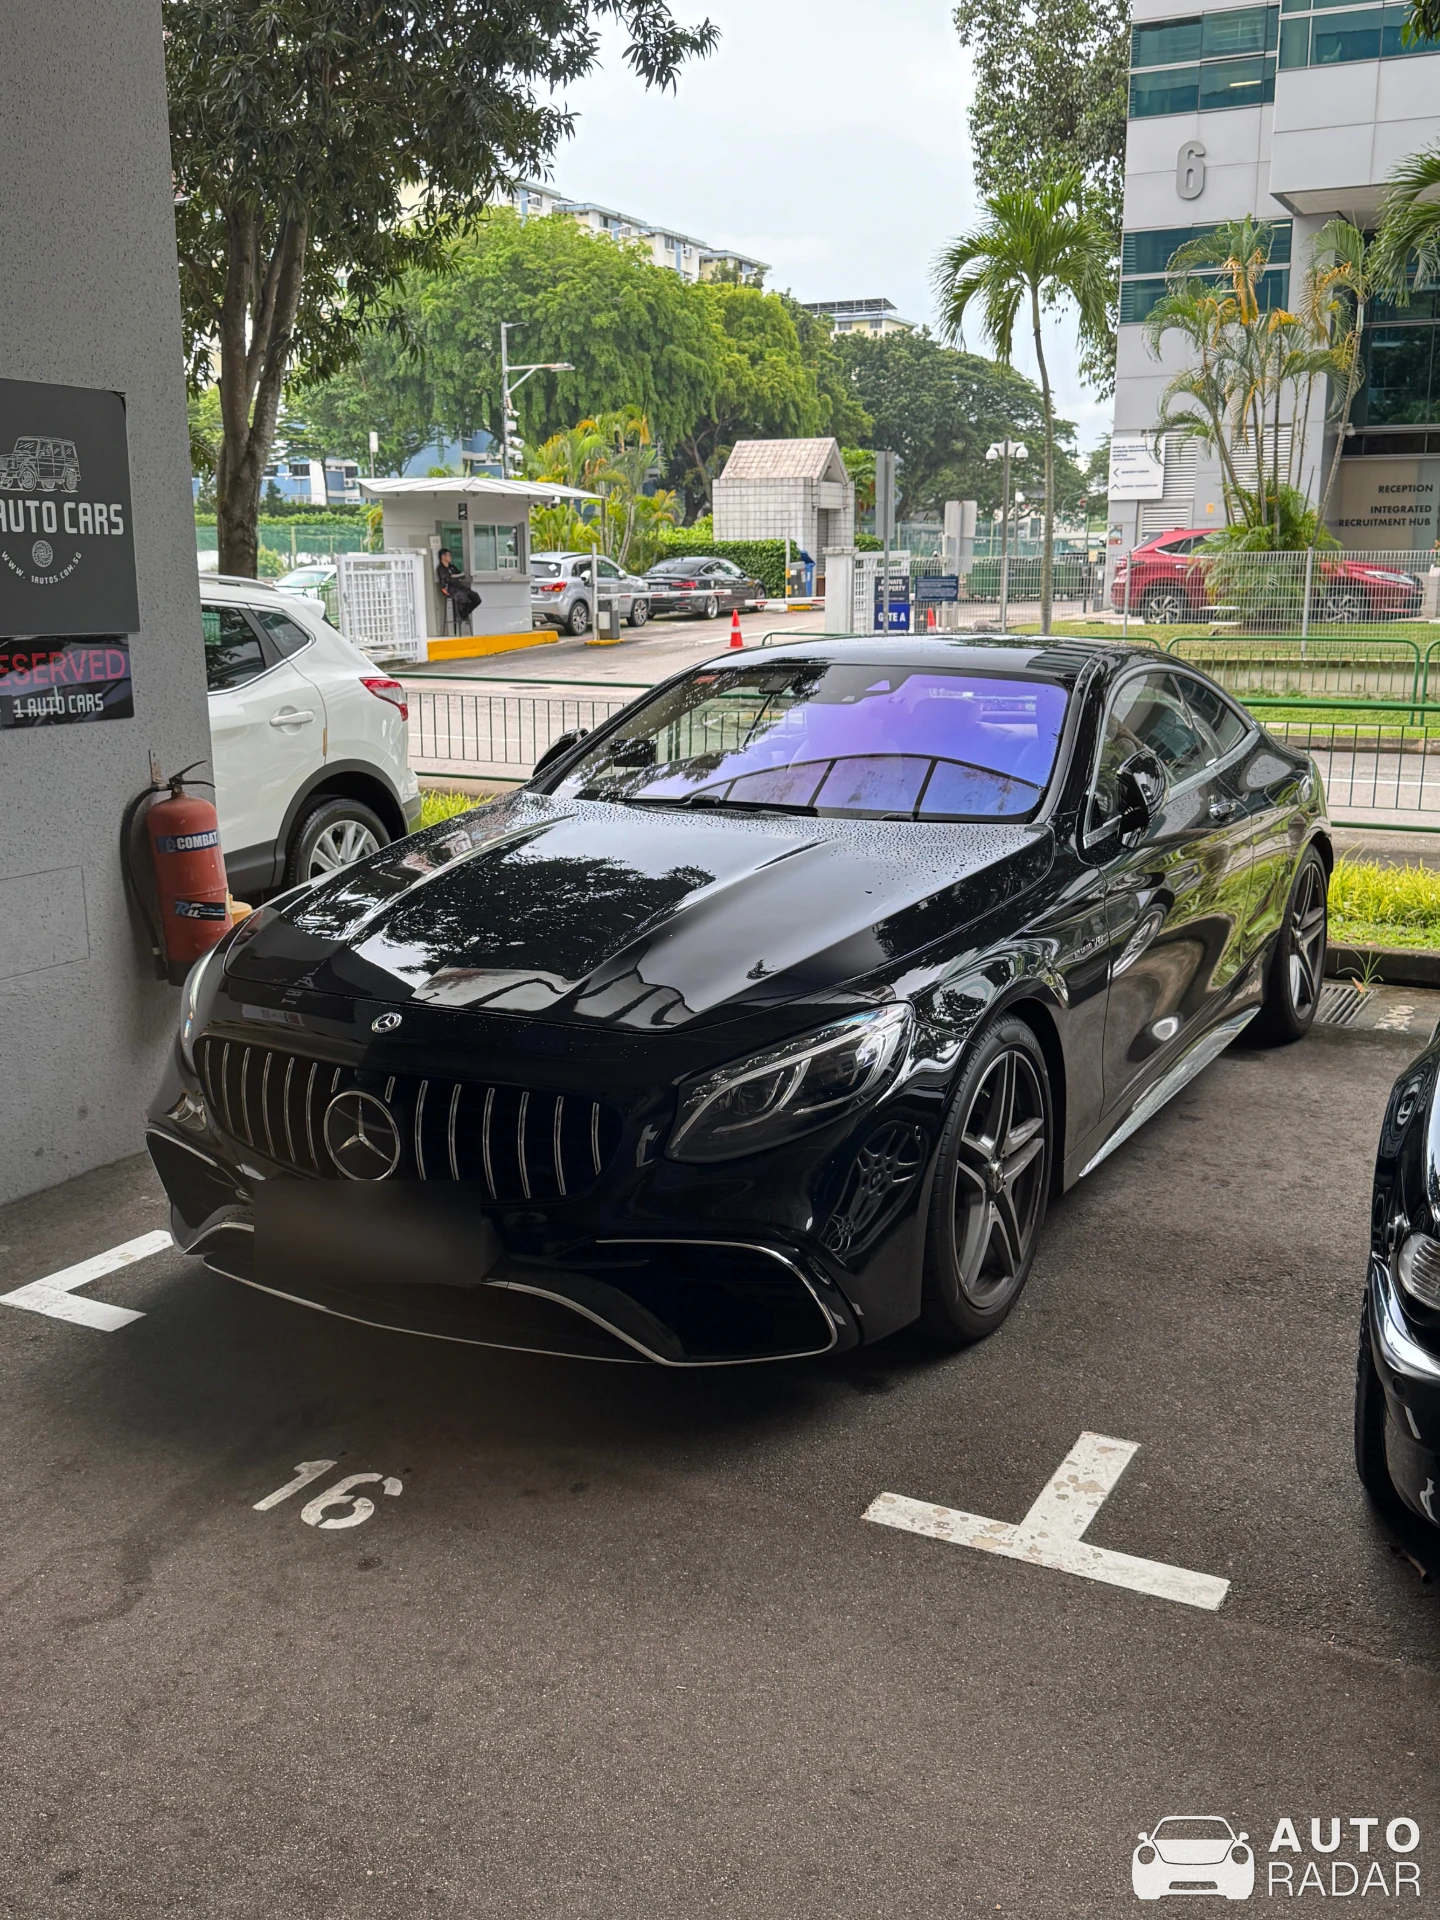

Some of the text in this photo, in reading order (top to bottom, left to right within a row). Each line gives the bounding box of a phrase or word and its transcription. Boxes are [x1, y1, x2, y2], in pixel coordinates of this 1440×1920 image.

[1176, 140, 1206, 200] 6
[1378, 484, 1434, 493] RECEPTION
[63, 501, 124, 535] CARS
[1370, 505, 1432, 513] INTEGRATED
[1338, 517, 1431, 527] RECRUITMENT HUB
[877, 612, 906, 622] GTE A
[27, 696, 66, 717] AUTO
[68, 693, 104, 713] CARS
[176, 831, 218, 850] COMBAT
[252, 1459, 403, 1529] 16
